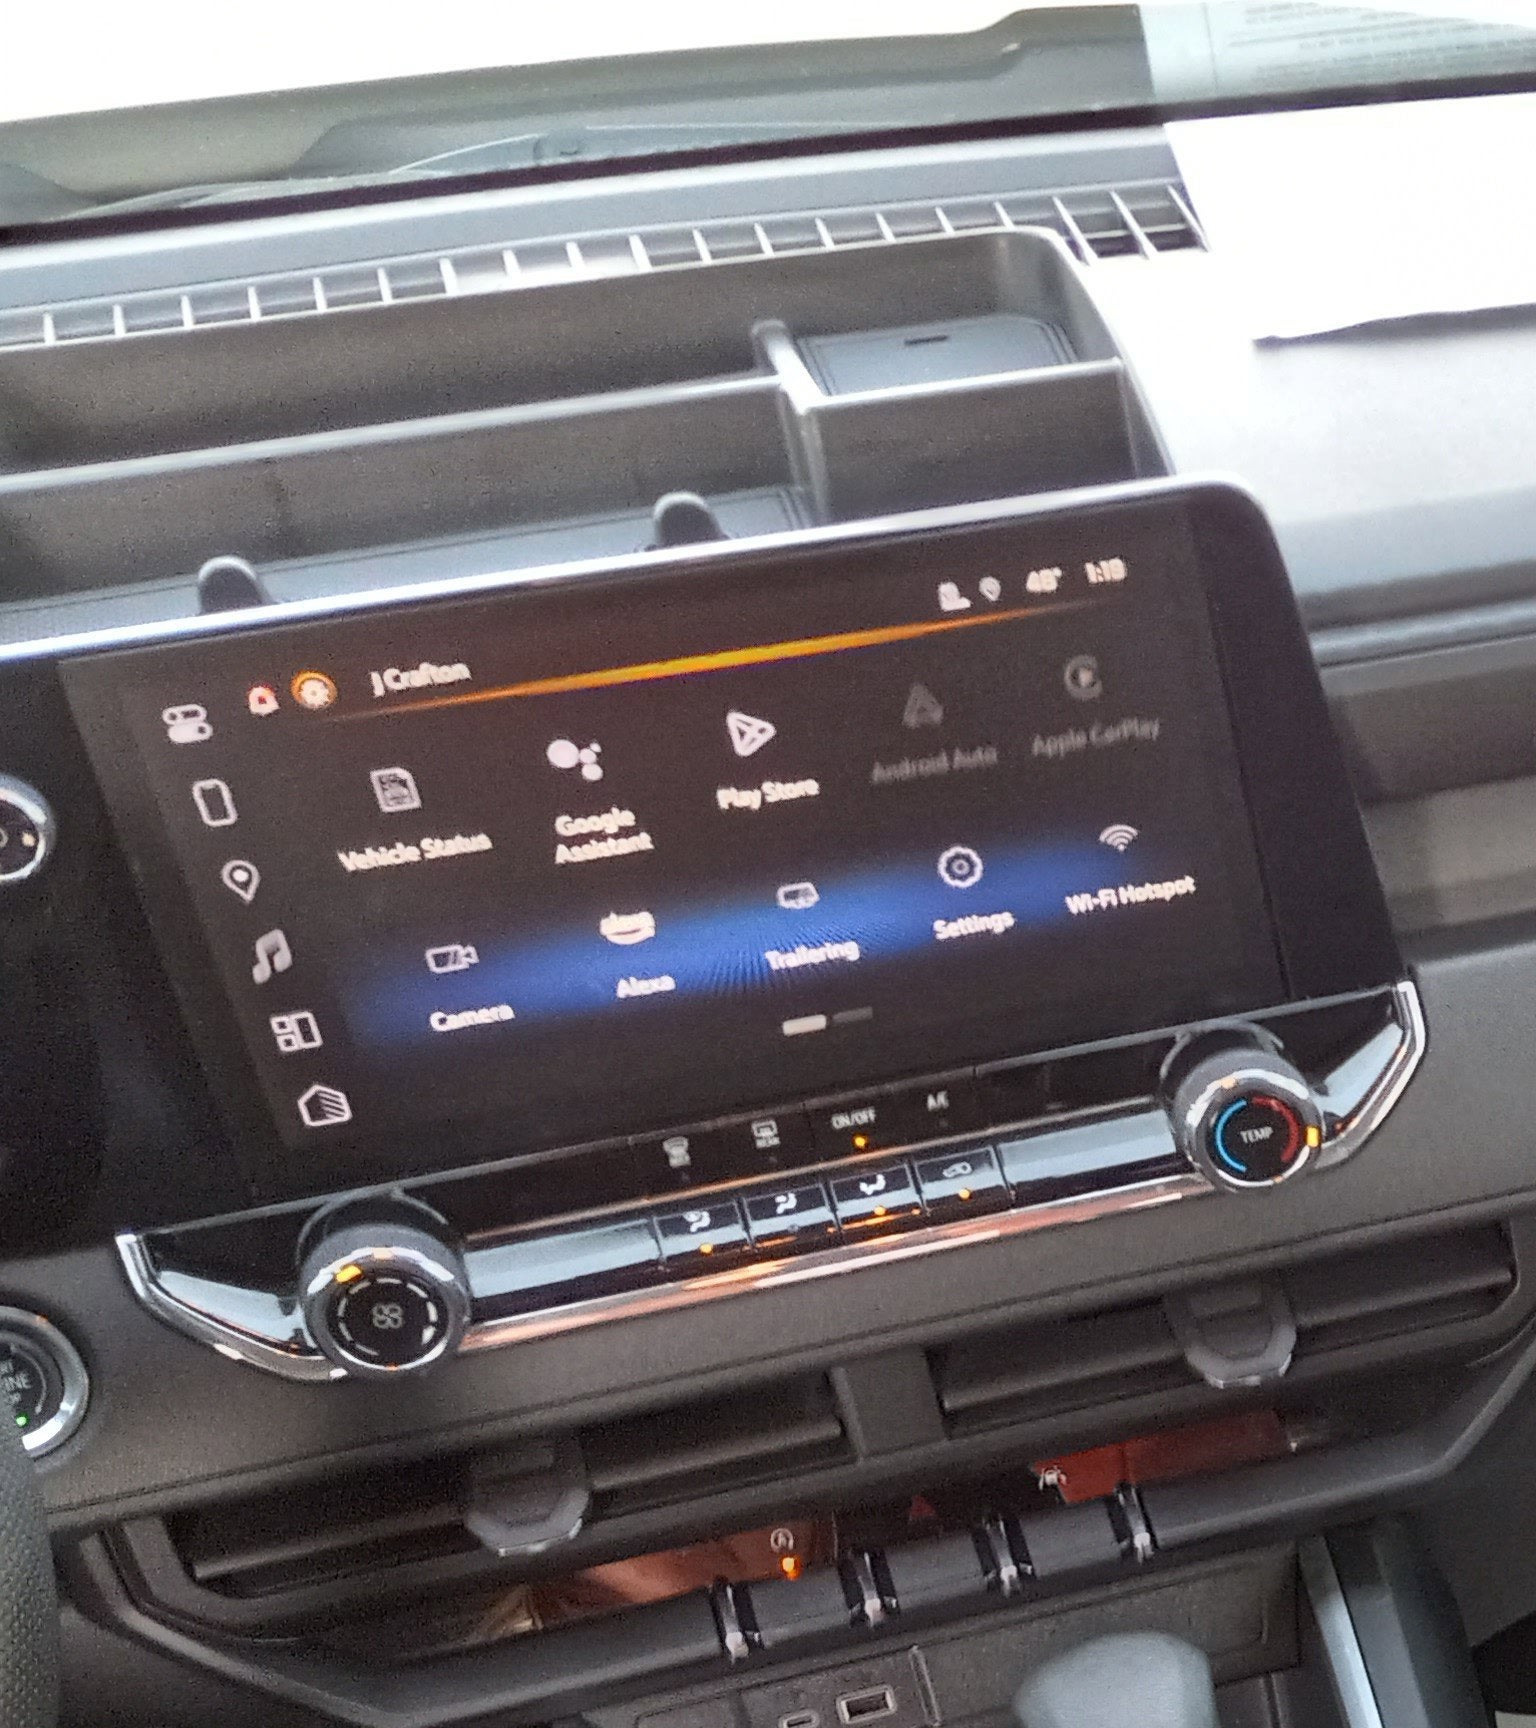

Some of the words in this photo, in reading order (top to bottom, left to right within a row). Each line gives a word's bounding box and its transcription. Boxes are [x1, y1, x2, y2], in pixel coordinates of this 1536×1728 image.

[383, 661, 473, 690] Crafton
[1032, 728, 1088, 759] Apple
[1088, 717, 1160, 747] CarPlay
[871, 749, 948, 784] Android
[952, 746, 998, 769] Auto
[716, 787, 762, 810] Play
[761, 778, 820, 803] Store
[554, 806, 636, 836] Google
[337, 842, 421, 872] Vehicle
[419, 832, 494, 860] Status
[554, 831, 655, 864] Assistant
[1065, 888, 1118, 915] Wi-Fi
[1118, 875, 1196, 905] Hotspot
[933, 911, 1015, 940] Settings
[765, 940, 861, 971] Trailering
[616, 975, 676, 998] Alexa
[429, 1003, 515, 1032] Camera
[831, 1106, 876, 1130] ON/OFF
[1240, 1126, 1274, 1145] TEMP
